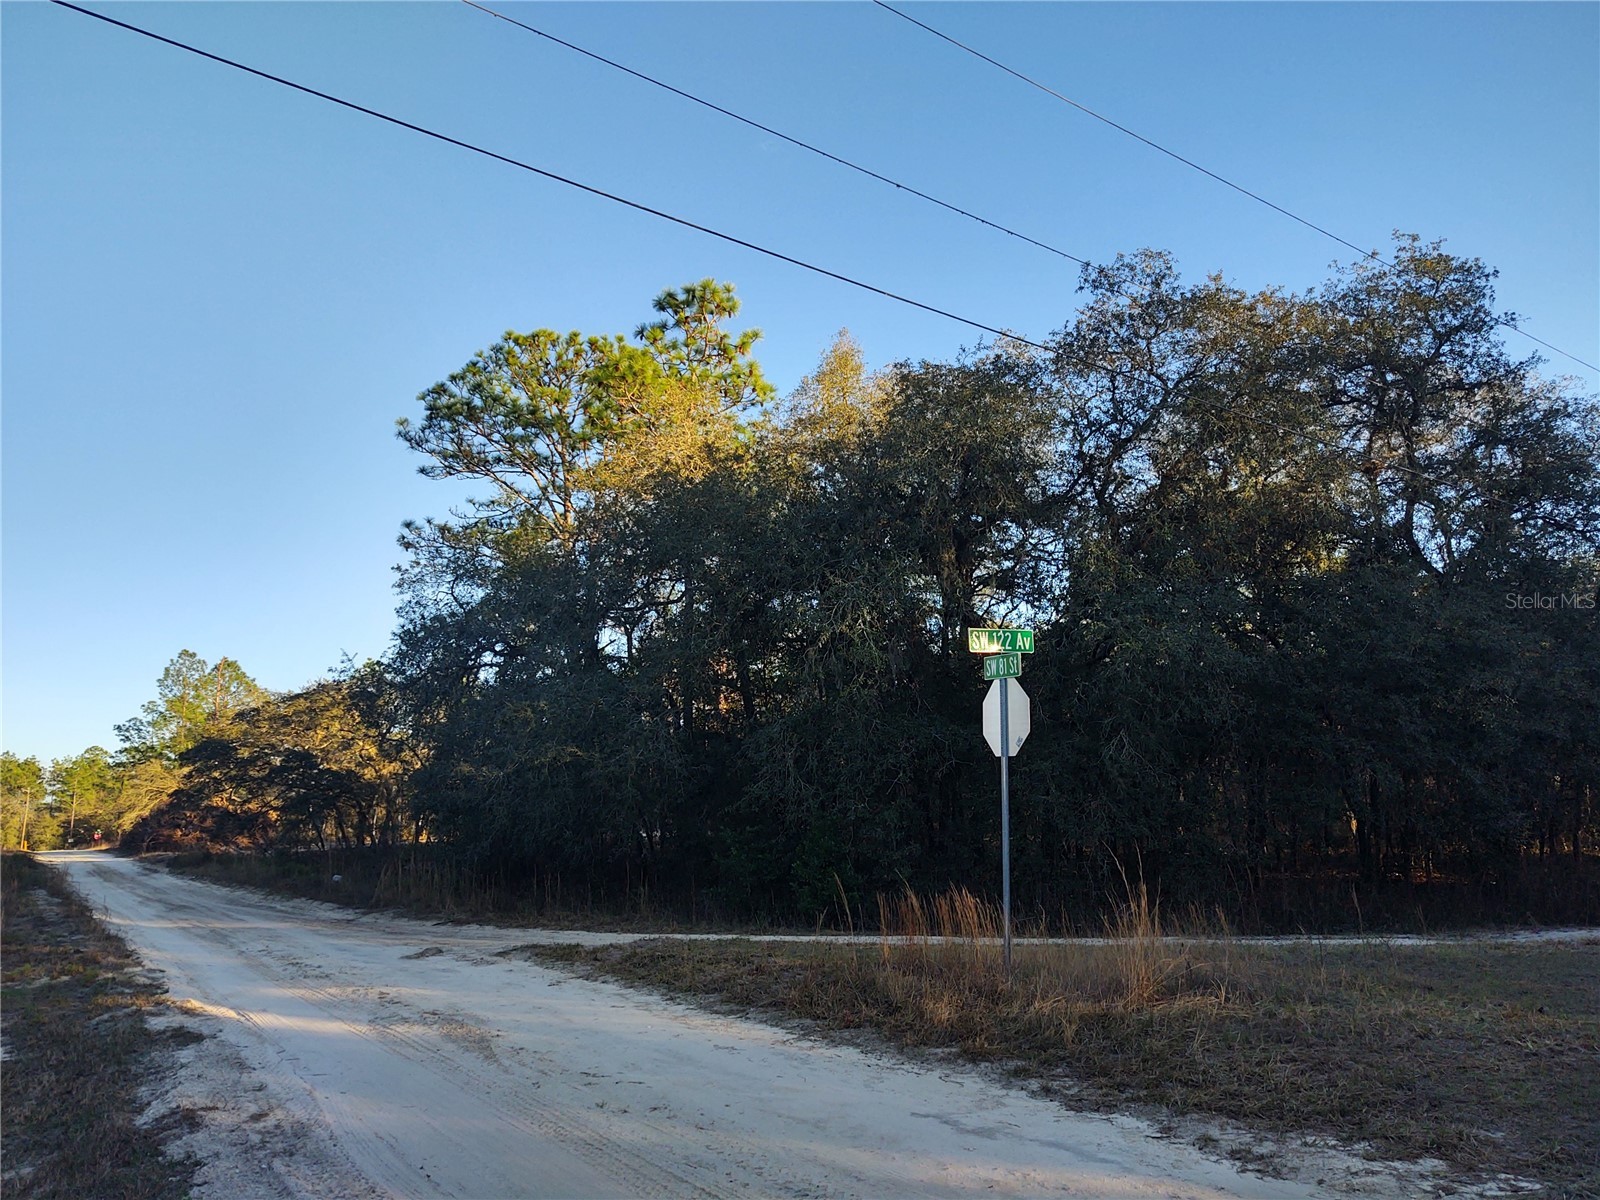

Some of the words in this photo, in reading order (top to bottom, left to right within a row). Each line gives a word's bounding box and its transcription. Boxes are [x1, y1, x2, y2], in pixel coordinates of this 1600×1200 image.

[972, 631, 989, 650] SW
[993, 632, 1012, 650] 122
[1016, 633, 1031, 650] Av
[986, 660, 997, 677] SW
[999, 658, 1007, 676] 81
[1009, 656, 1018, 674] St
